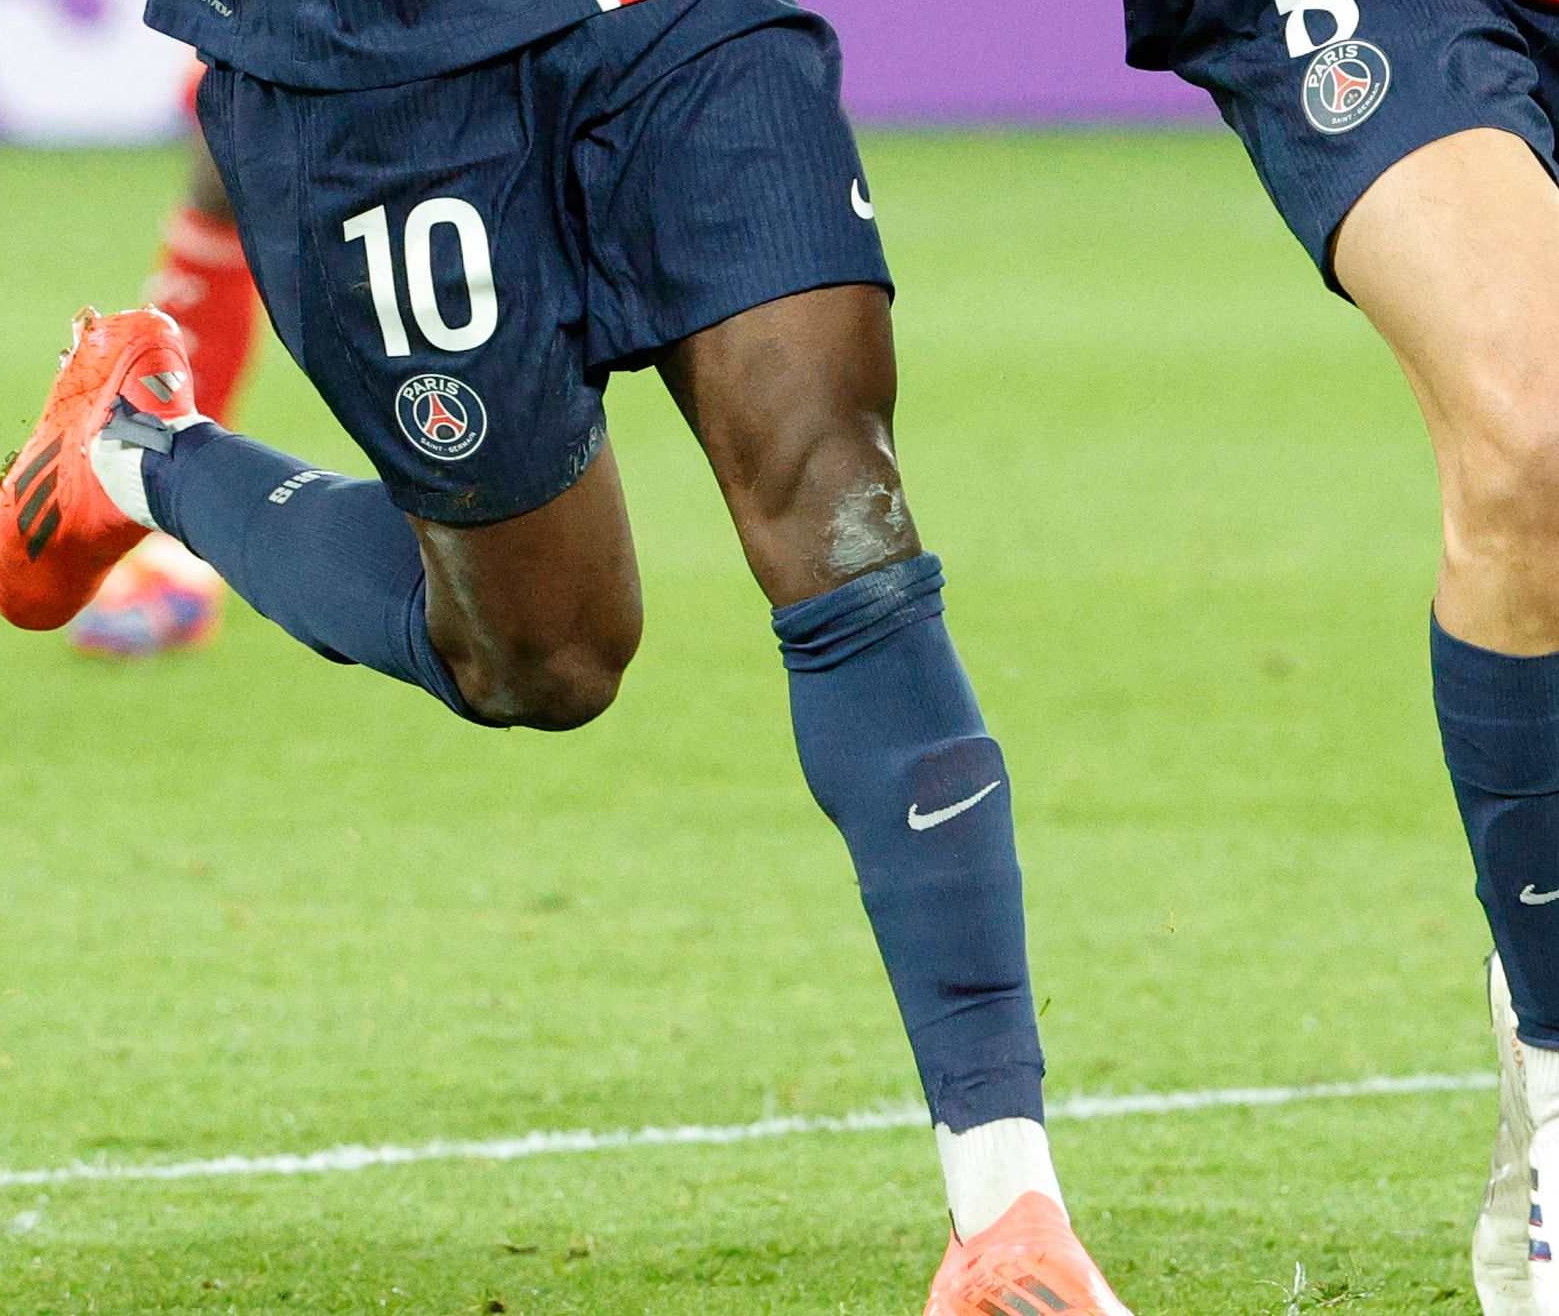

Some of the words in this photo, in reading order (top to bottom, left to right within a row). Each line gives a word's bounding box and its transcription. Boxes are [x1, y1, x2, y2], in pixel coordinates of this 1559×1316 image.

[1307, 44, 1359, 88] PARIS
[342, 196, 499, 358] 10
[403, 377, 460, 402] PARIS
